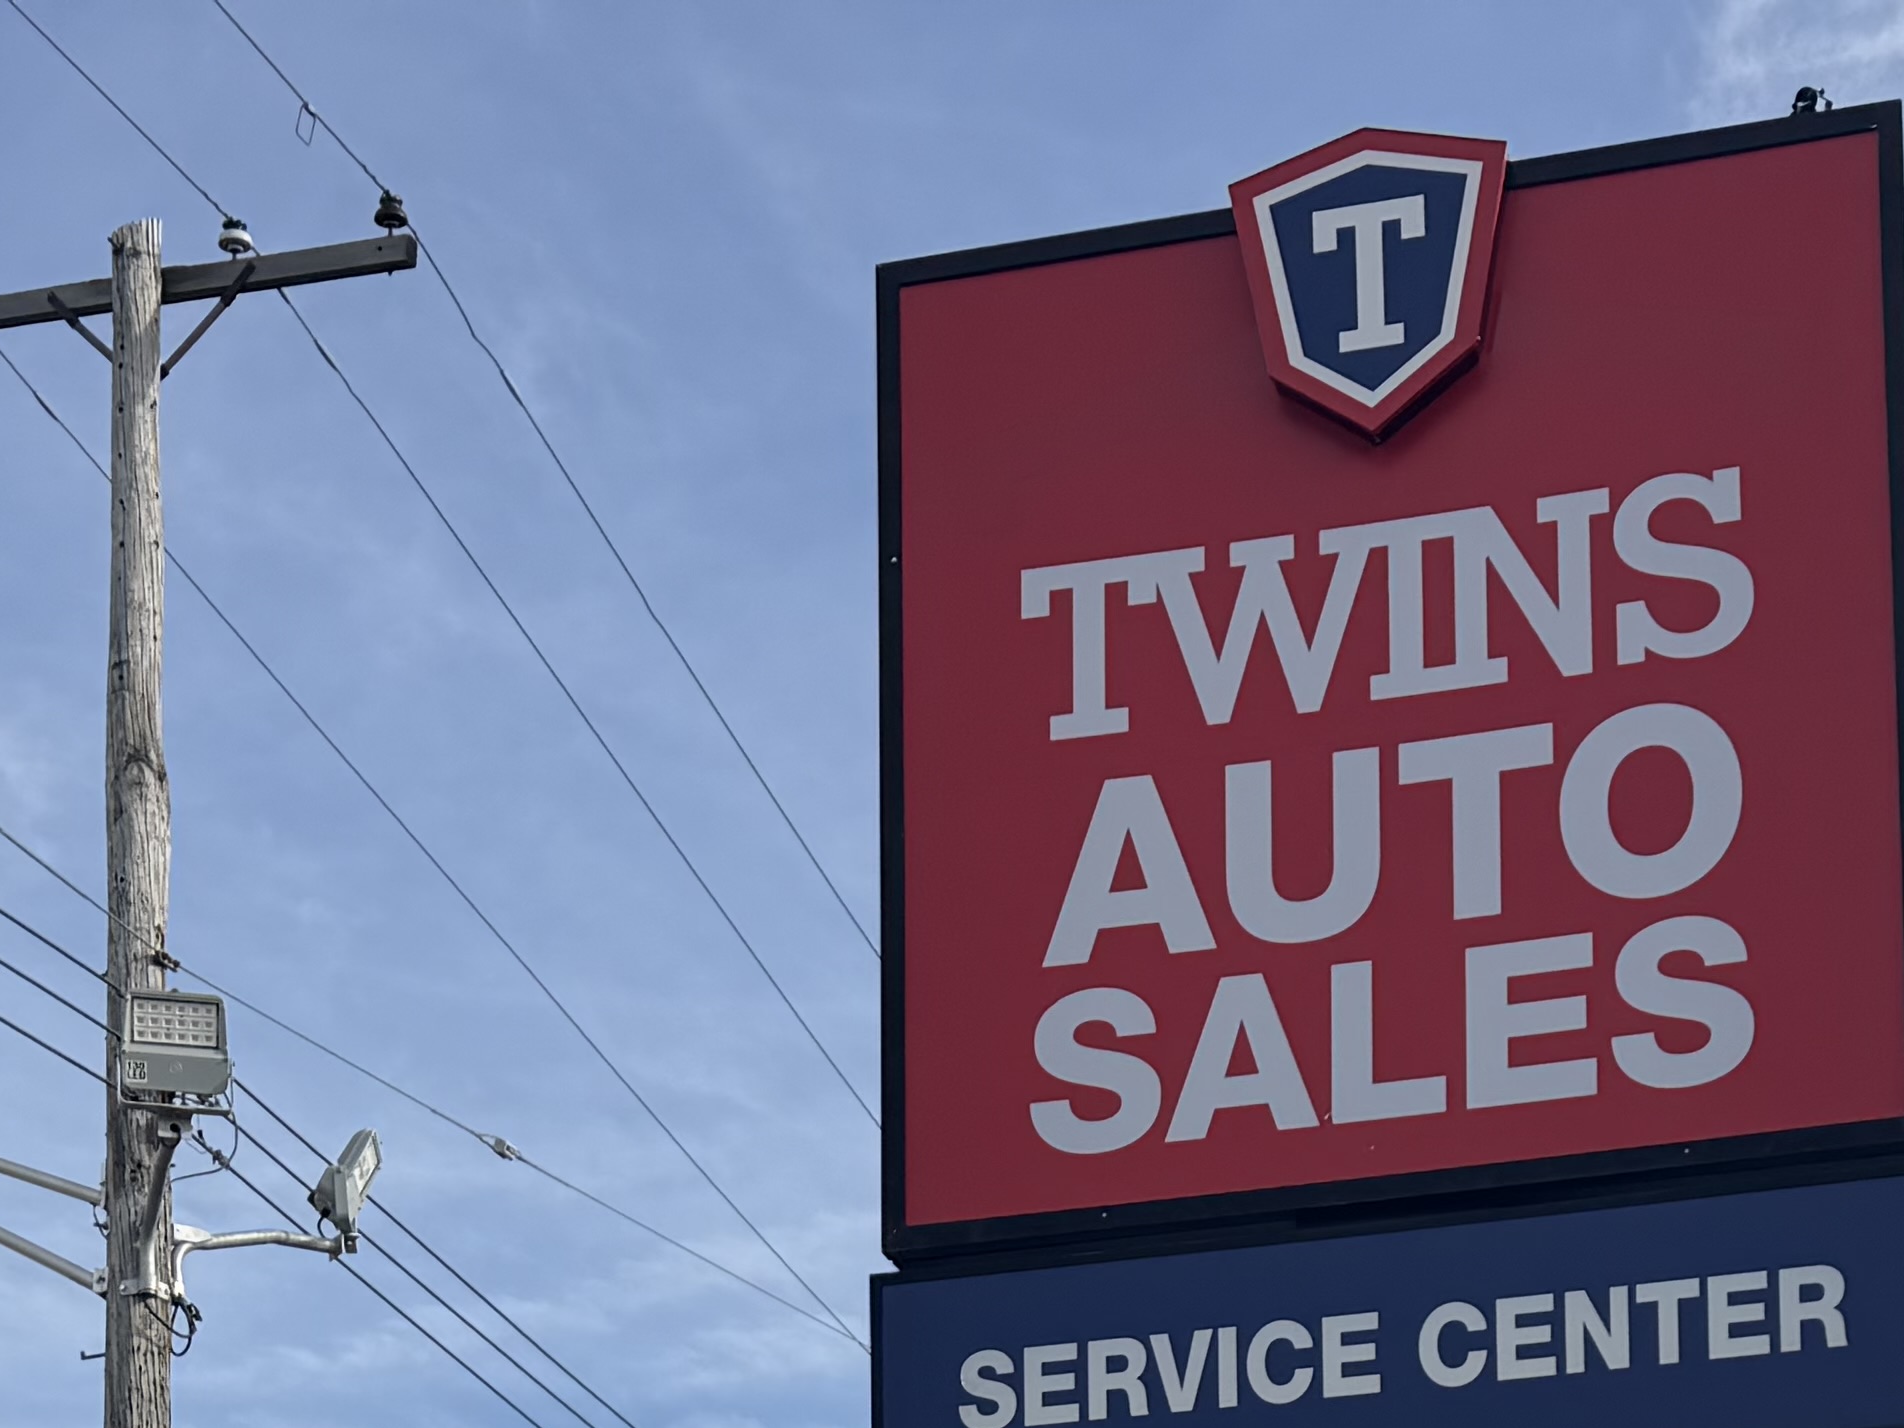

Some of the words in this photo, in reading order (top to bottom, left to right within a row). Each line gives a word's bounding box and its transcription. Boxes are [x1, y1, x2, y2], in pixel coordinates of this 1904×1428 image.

[1311, 193, 1426, 355] T
[1020, 465, 1756, 741] TWINS
[1040, 701, 1744, 969] AUTO
[1028, 914, 1757, 1156] SALES
[1418, 1263, 1849, 1389] CENTER
